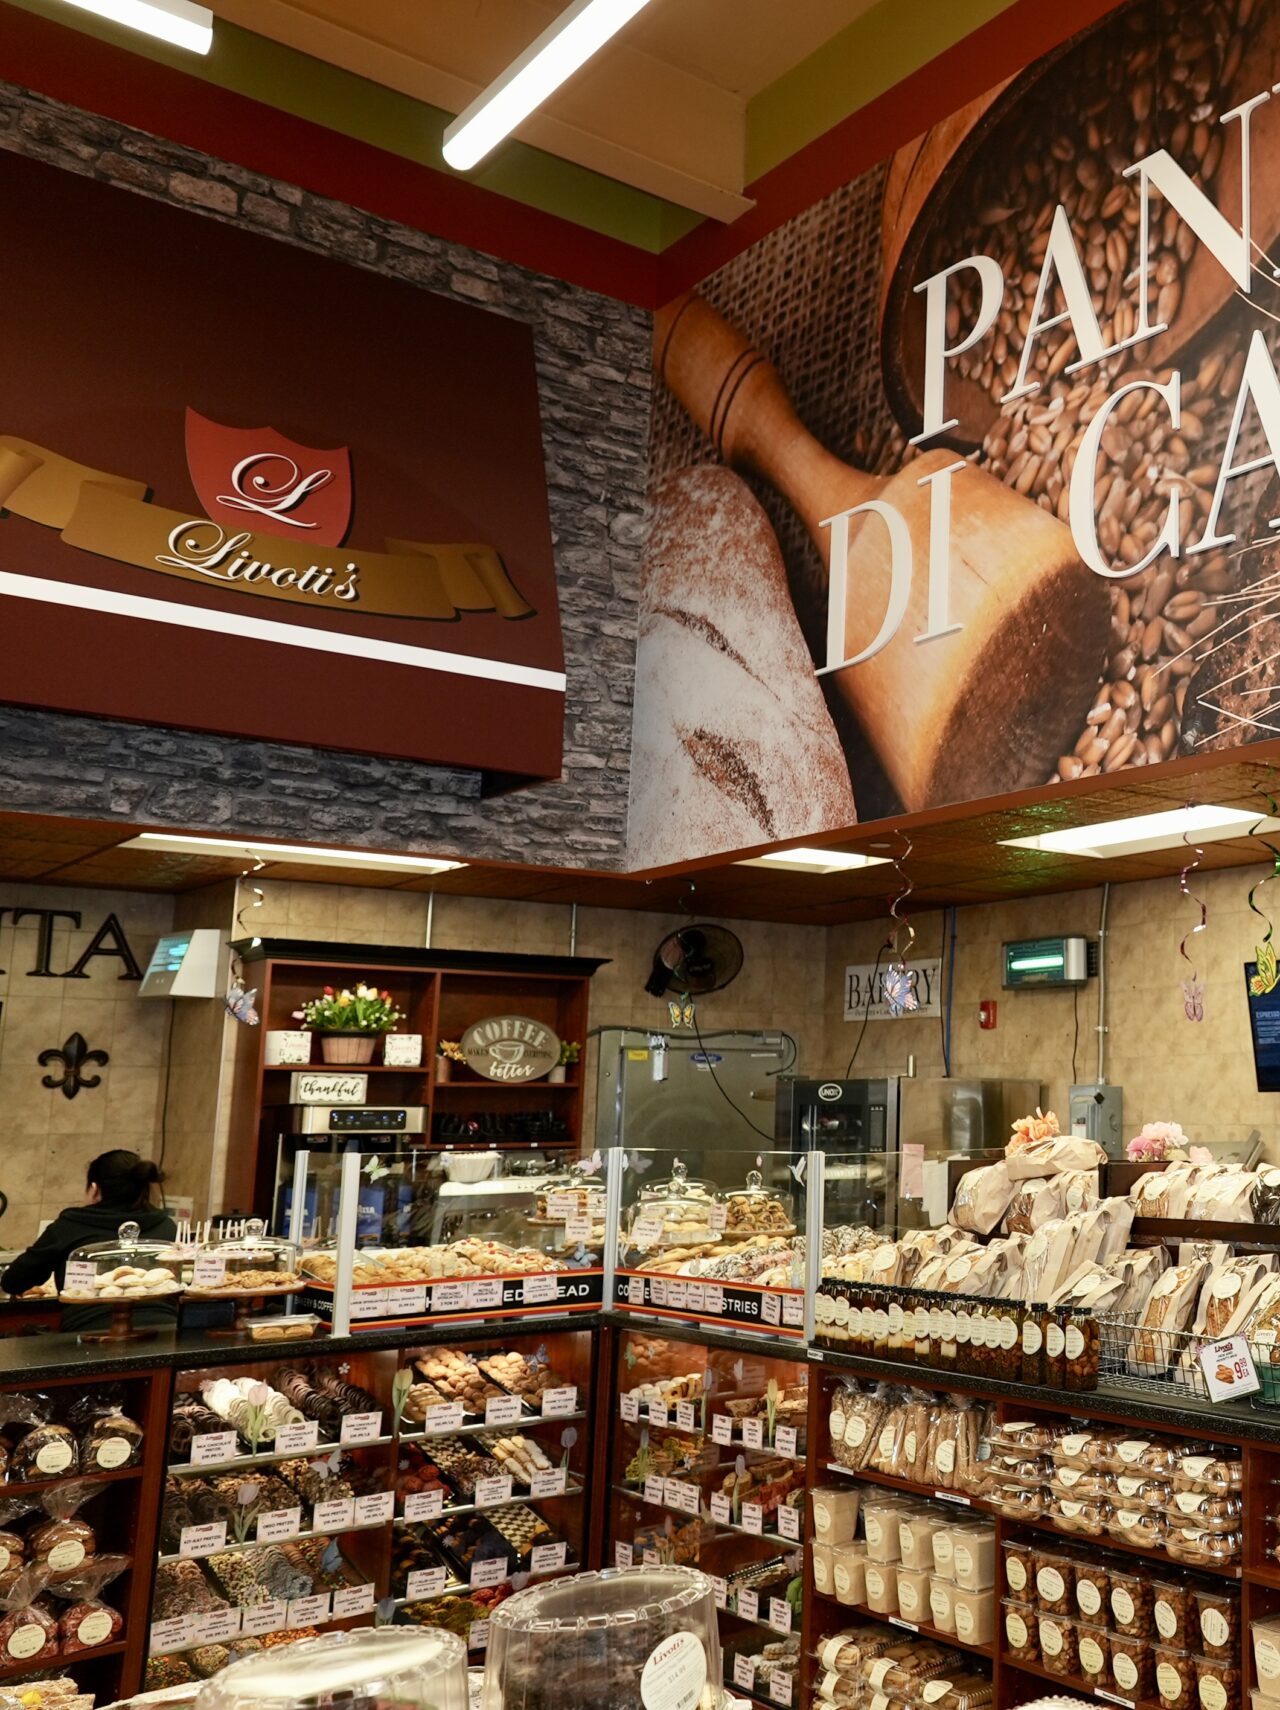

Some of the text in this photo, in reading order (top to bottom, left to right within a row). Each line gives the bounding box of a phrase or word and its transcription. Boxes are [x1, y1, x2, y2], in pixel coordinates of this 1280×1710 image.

[155, 520, 361, 603] Livoti's
[815, 460, 966, 677] DI
[472, 1019, 549, 1049] COFFEE
[489, 1061, 535, 1079] better
[303, 1080, 360, 1097] thankful
[1234, 1361, 1243, 1379] 9
